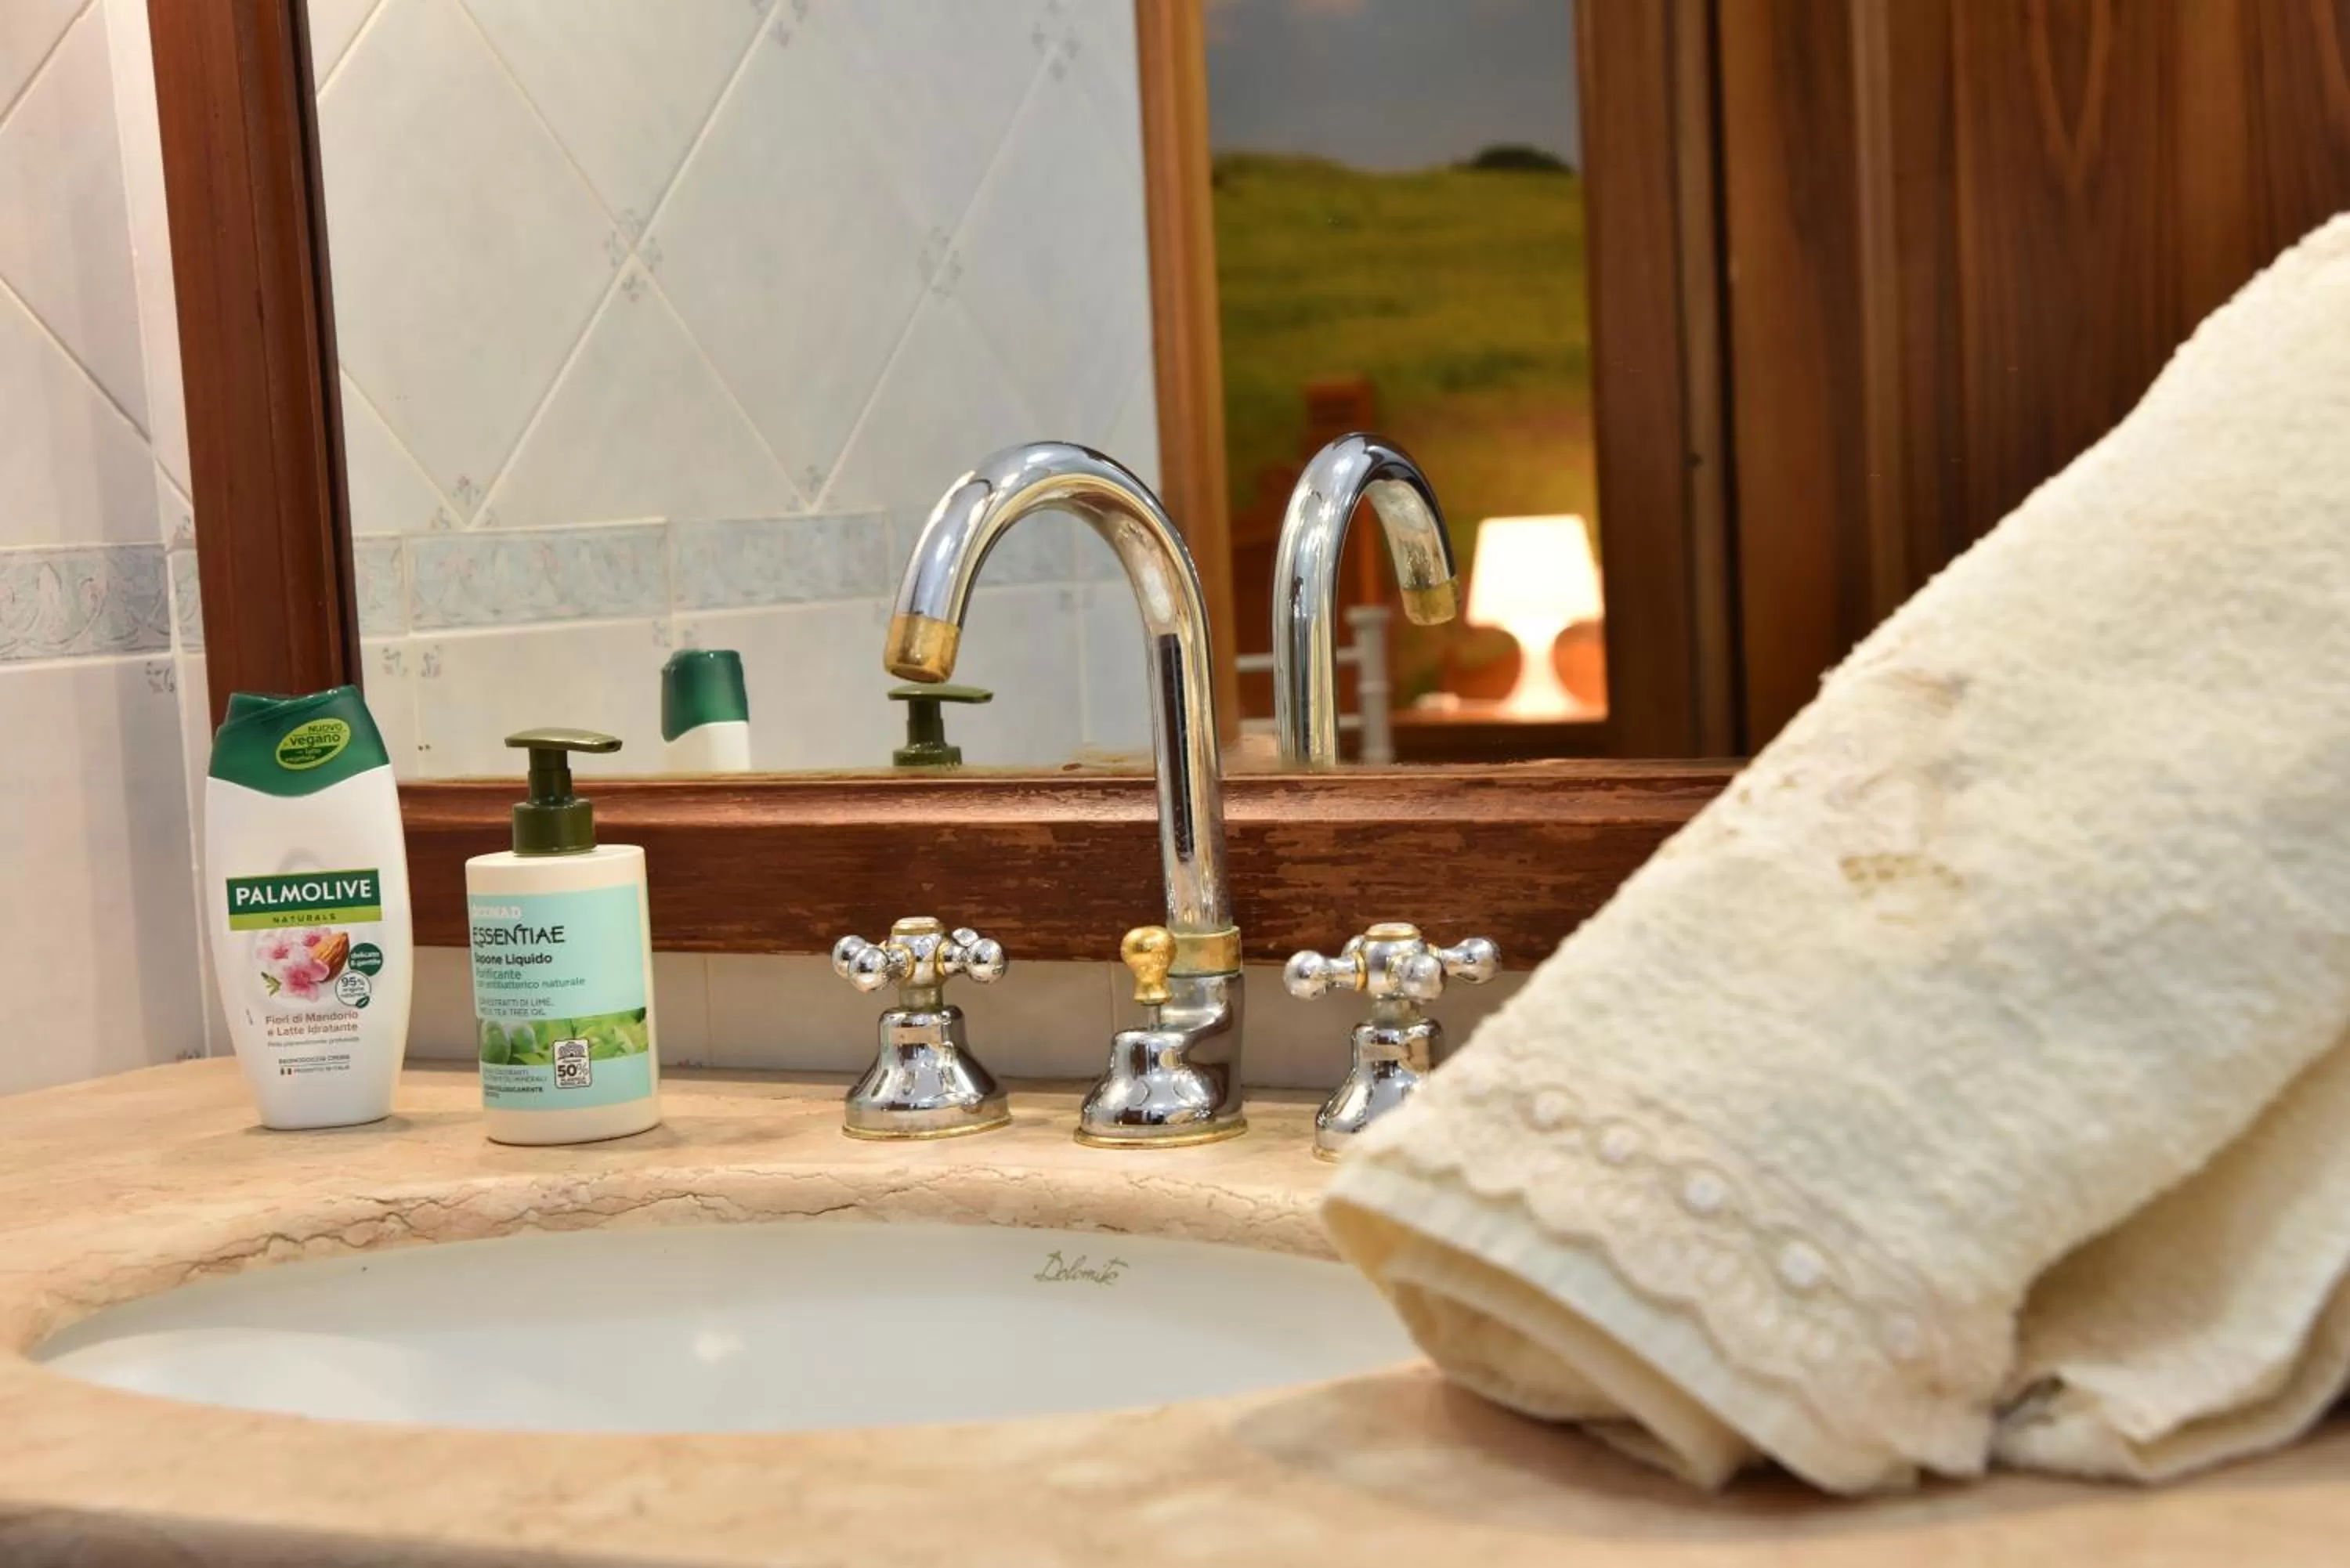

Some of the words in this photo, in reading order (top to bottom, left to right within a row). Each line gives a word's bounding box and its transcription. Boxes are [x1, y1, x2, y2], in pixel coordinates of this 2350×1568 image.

[308, 723, 342, 733] NUOVO
[289, 733, 341, 748] vegano
[236, 879, 371, 906] PALMOLIVE
[273, 912, 337, 924] NATURALS
[472, 923, 566, 948] ESSENTIAE
[505, 952, 553, 966] Liquido
[342, 976, 365, 988] 95%
[541, 977, 586, 988] naturale
[266, 1014, 290, 1024] Fiori
[292, 1013, 303, 1023] di
[267, 1028, 274, 1037] e
[277, 1027, 305, 1036] Latte
[558, 1061, 588, 1078] 50%
